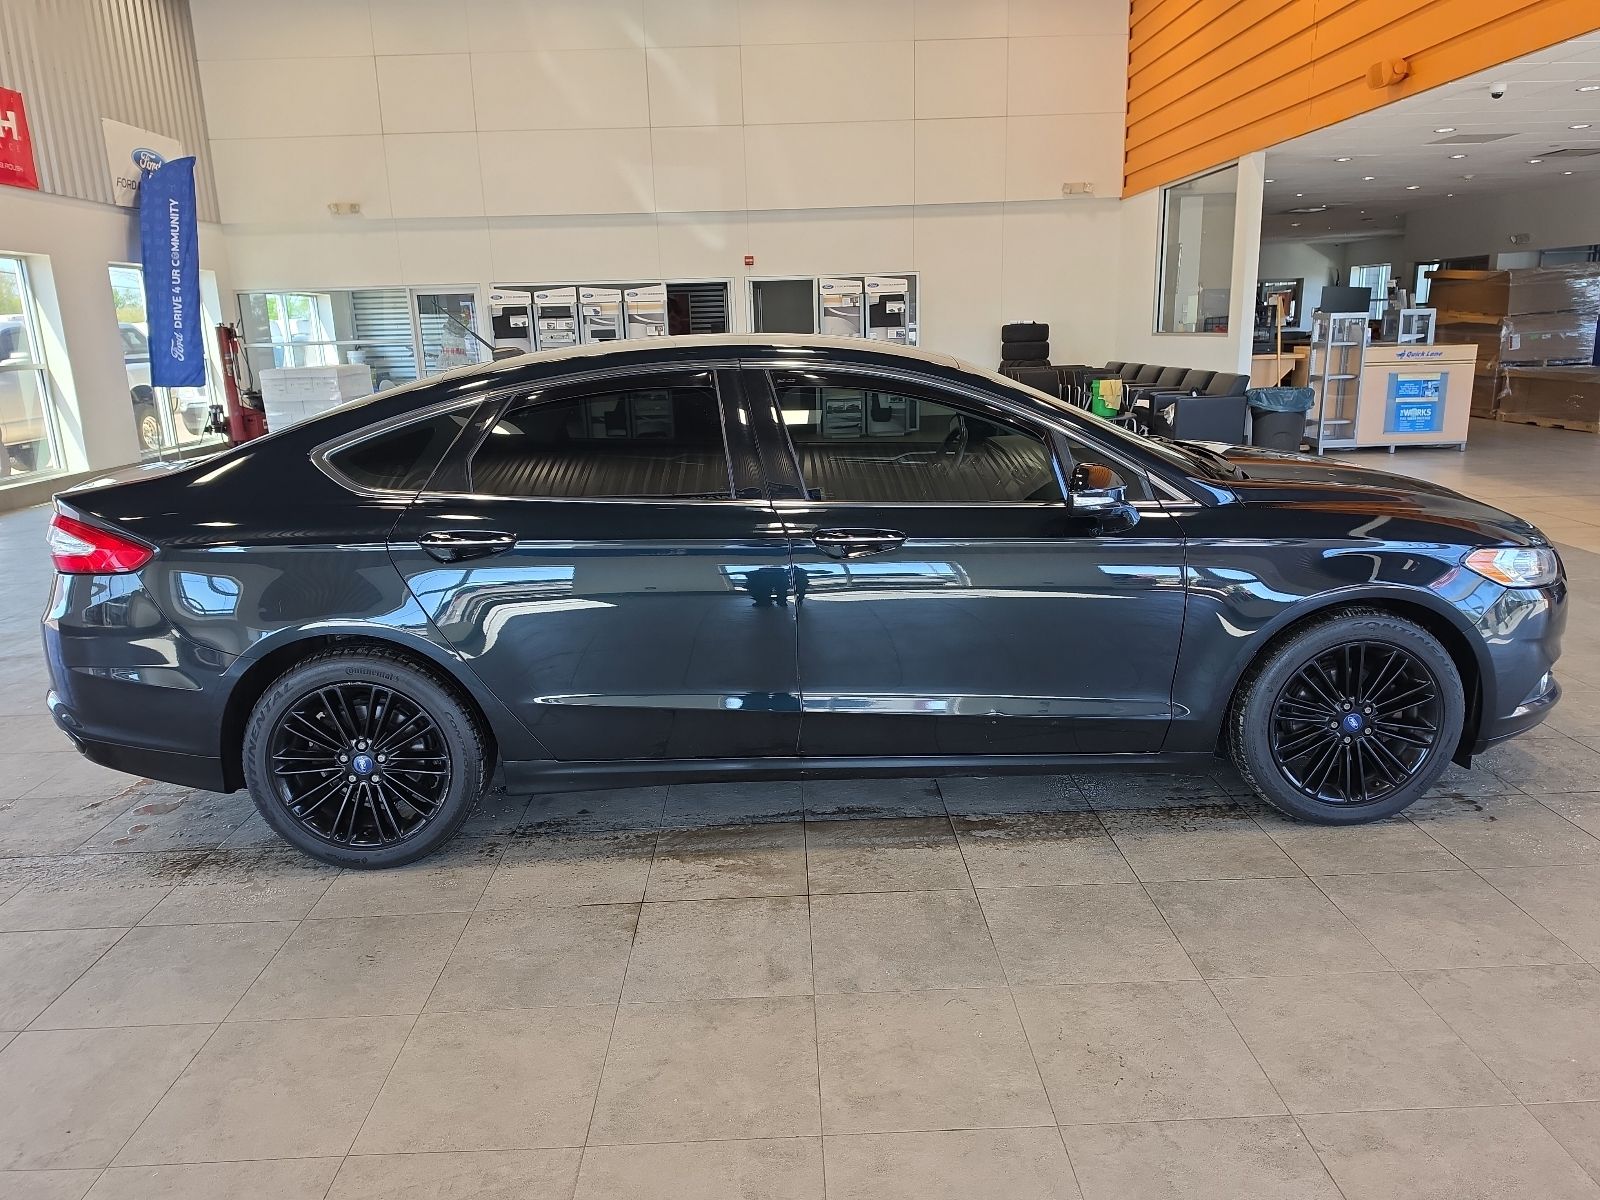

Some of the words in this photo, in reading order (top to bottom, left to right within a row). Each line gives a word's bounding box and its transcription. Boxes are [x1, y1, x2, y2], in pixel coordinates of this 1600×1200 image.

[116, 177, 137, 190] FORD
[168, 198, 181, 267] COMMUNITY
[171, 268, 181, 285] UR
[171, 285, 182, 294] 4
[172, 295, 183, 329] DRIVE
[170, 331, 185, 362] Ford
